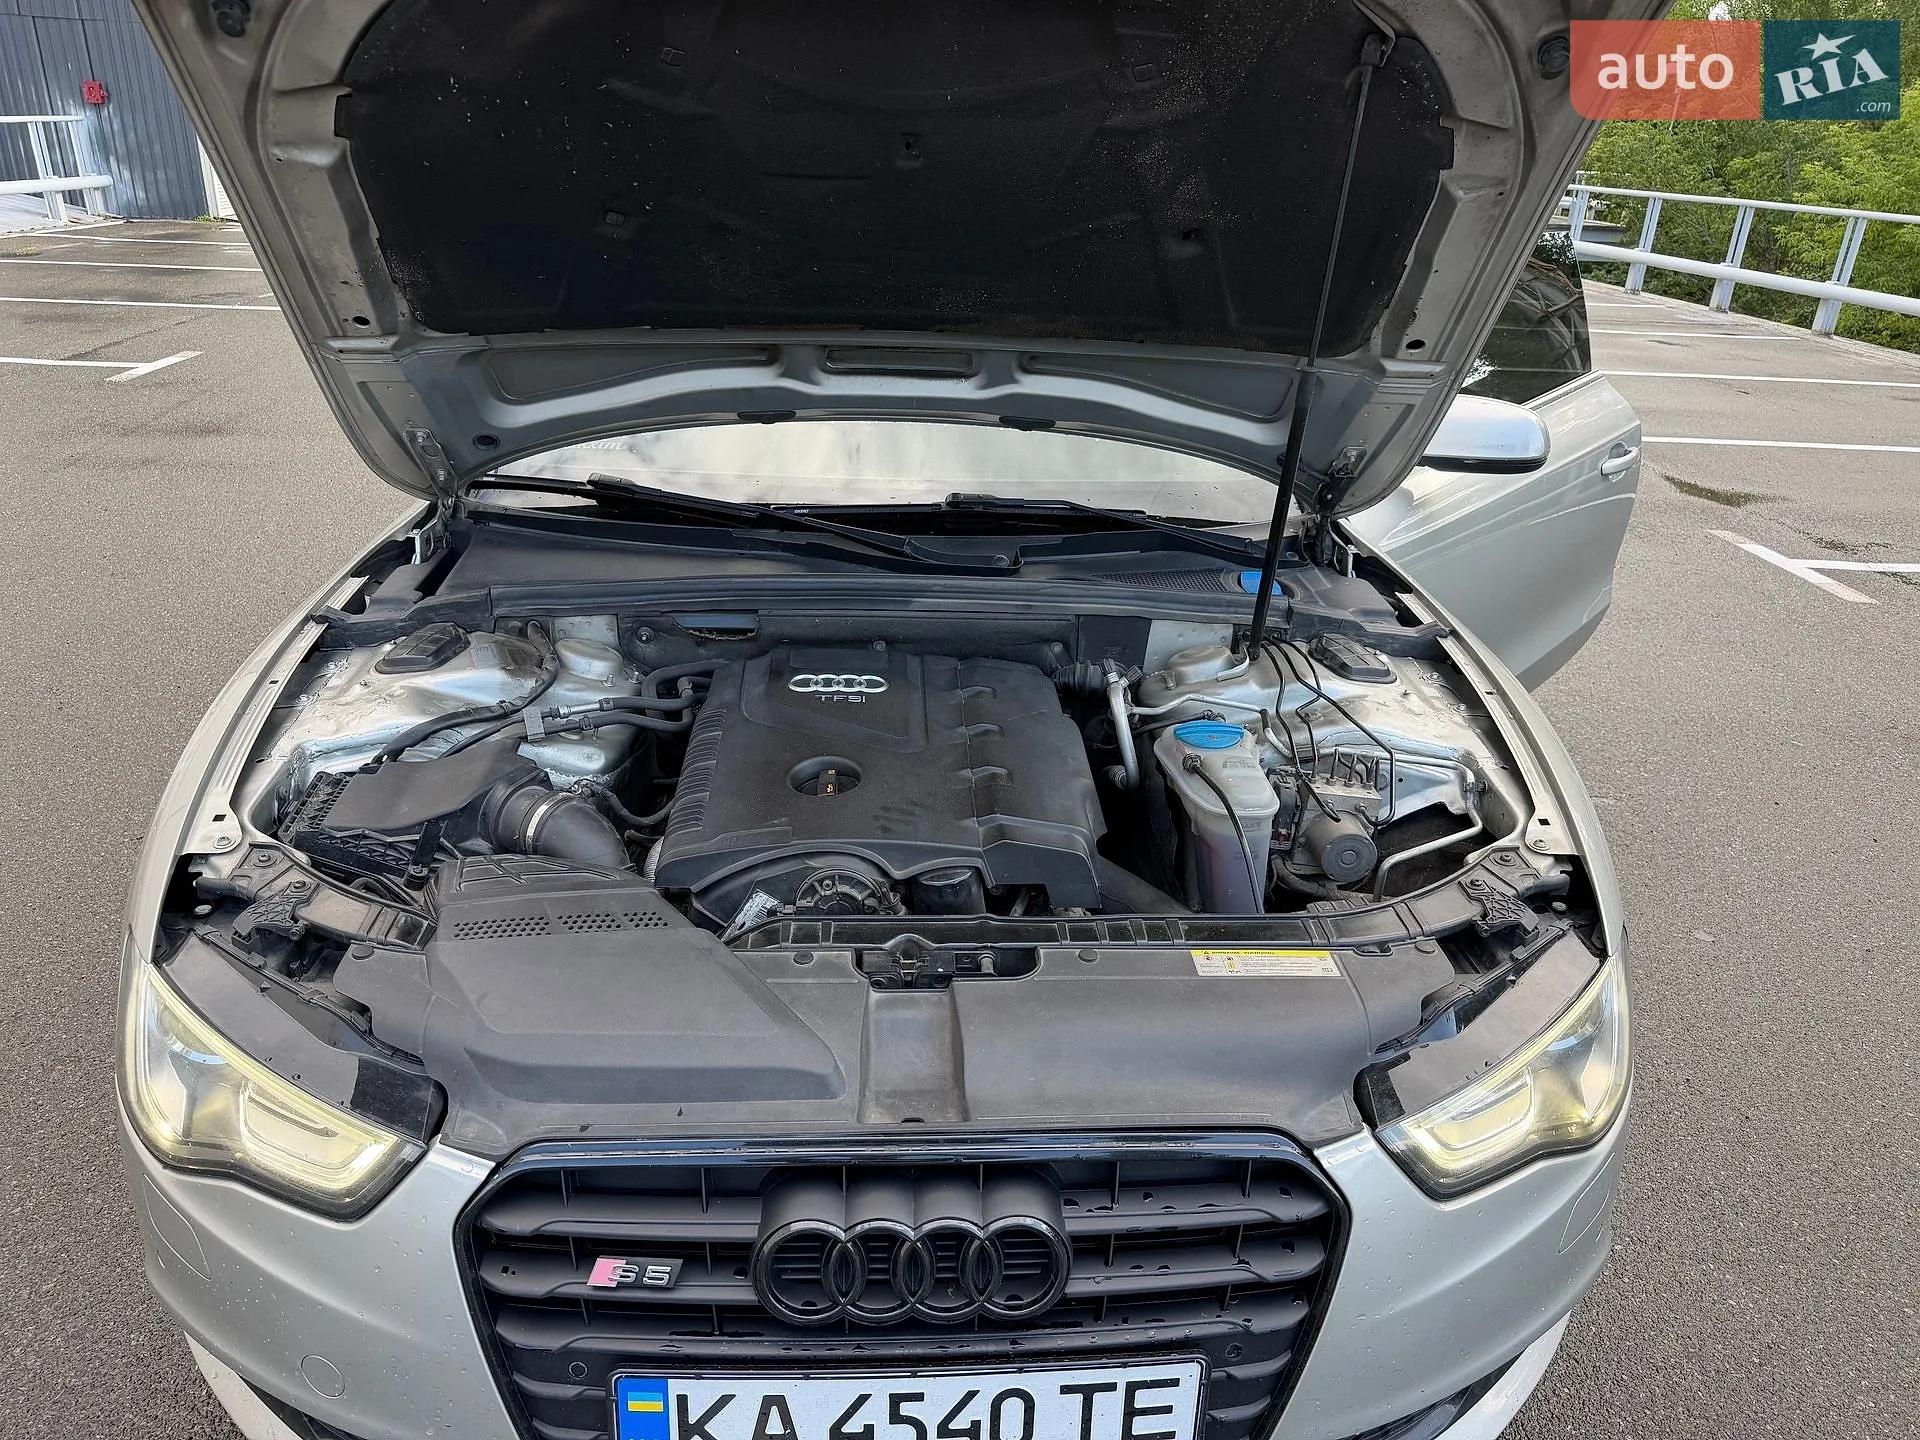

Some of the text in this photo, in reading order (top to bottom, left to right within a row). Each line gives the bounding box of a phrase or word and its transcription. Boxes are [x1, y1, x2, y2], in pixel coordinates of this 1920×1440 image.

[814, 694, 866, 703] TFSI
[608, 1263, 672, 1286] S5
[675, 1377, 1181, 1440] KA 4540 TE
